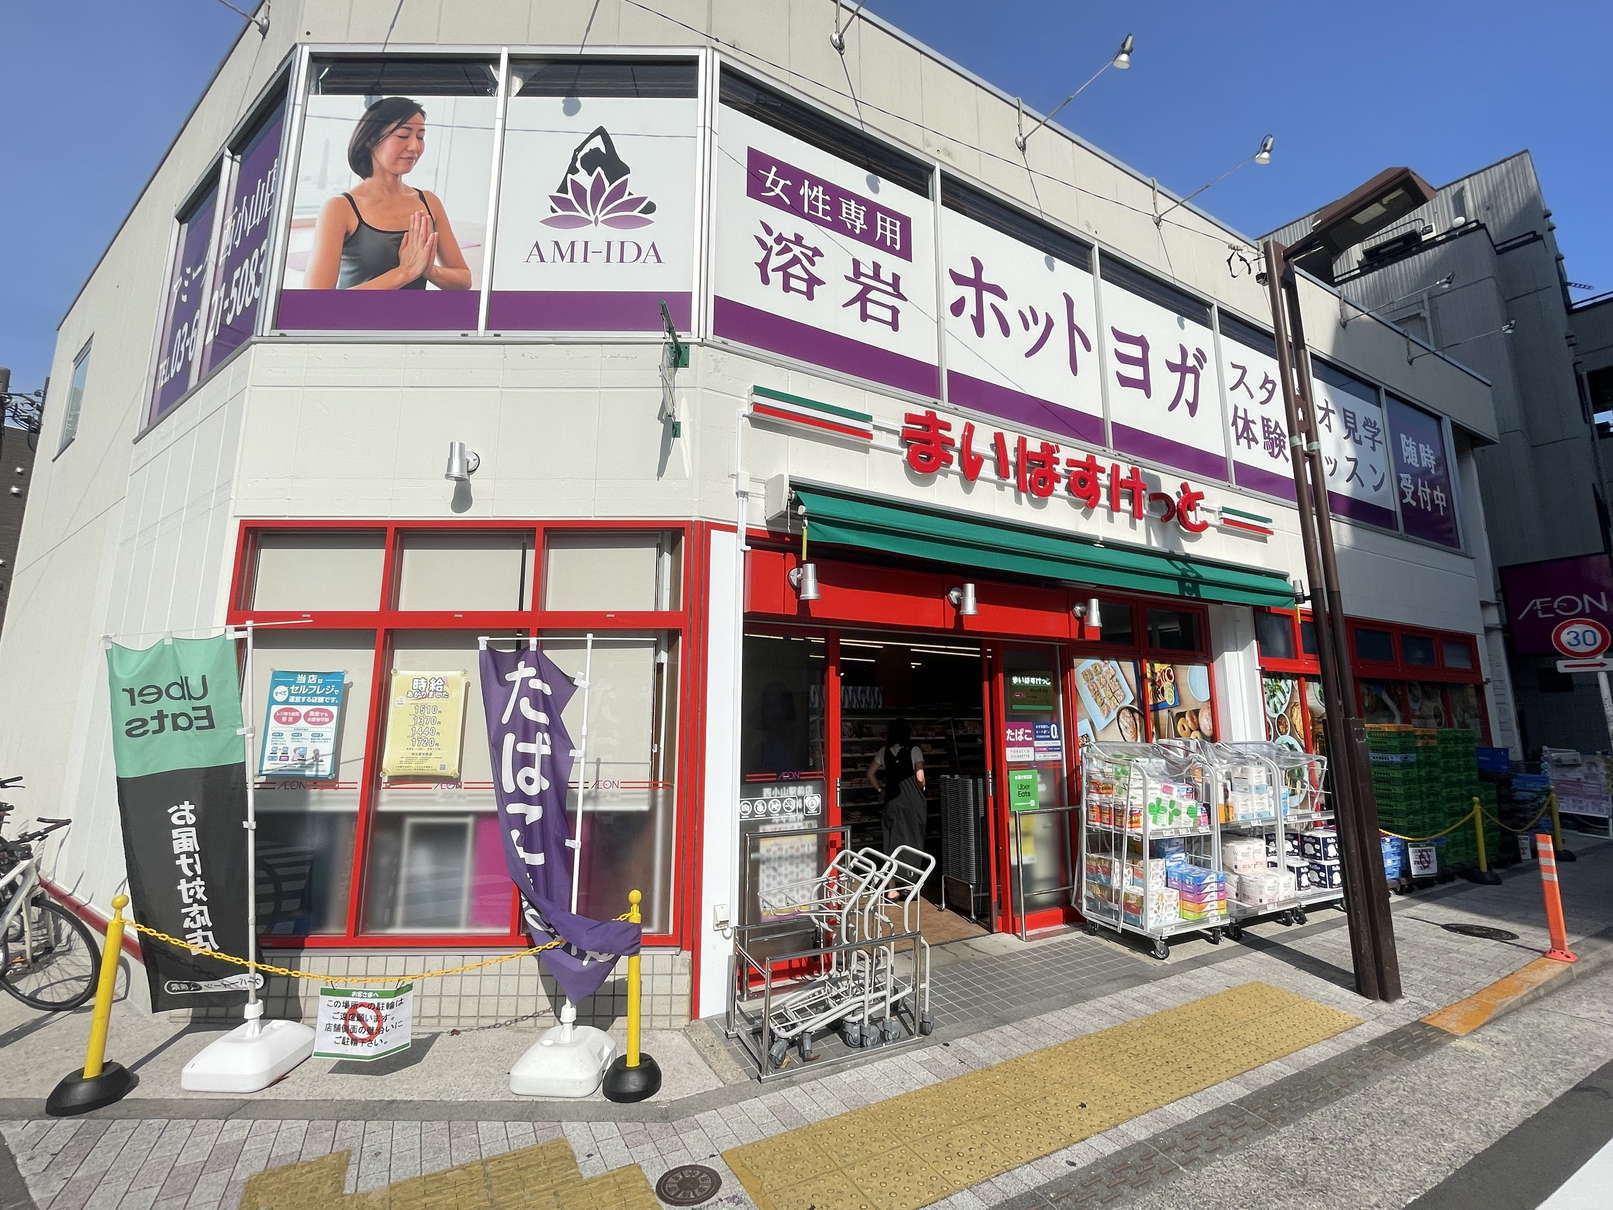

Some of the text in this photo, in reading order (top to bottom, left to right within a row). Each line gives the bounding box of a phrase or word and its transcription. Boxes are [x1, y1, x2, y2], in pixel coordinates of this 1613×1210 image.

[757, 165, 902, 252] 女性専用
[522, 240, 665, 265] AMI-IDA
[1230, 361, 1383, 452] スタオ見学
[1231, 404, 1385, 492] 体験ッスン
[1400, 433, 1437, 474] 随時
[901, 410, 1209, 533] まいばすけっと
[1399, 473, 1448, 516] 受付中
[1566, 629, 1598, 647] 30
[412, 677, 445, 692] 時給
[1006, 728, 1033, 741] たばこ
[501, 660, 552, 867] たばこ
